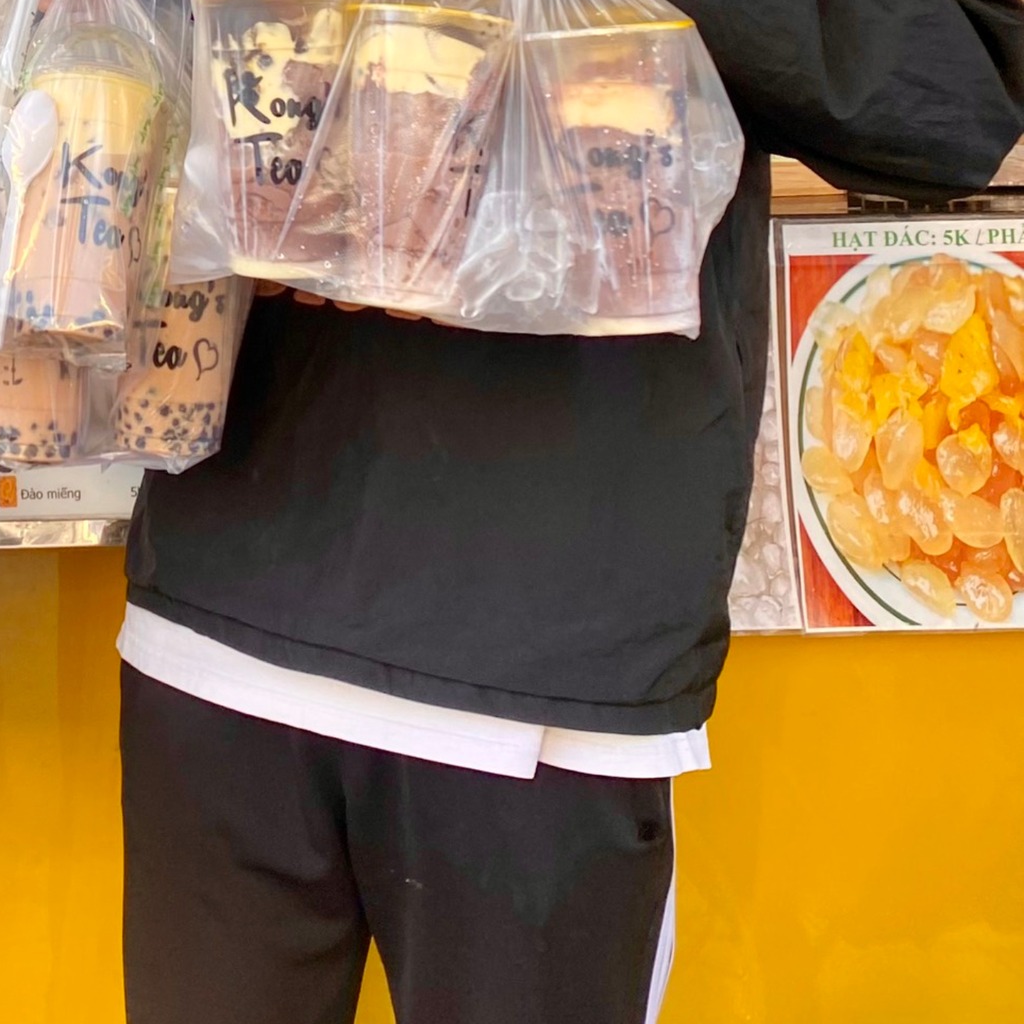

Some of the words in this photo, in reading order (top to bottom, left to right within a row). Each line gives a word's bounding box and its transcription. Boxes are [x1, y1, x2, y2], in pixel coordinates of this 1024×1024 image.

[832, 230, 878, 251] HẠT
[884, 225, 936, 247] ĐÁC:
[943, 229, 970, 246] 5K
[20, 487, 44, 499] Đào
